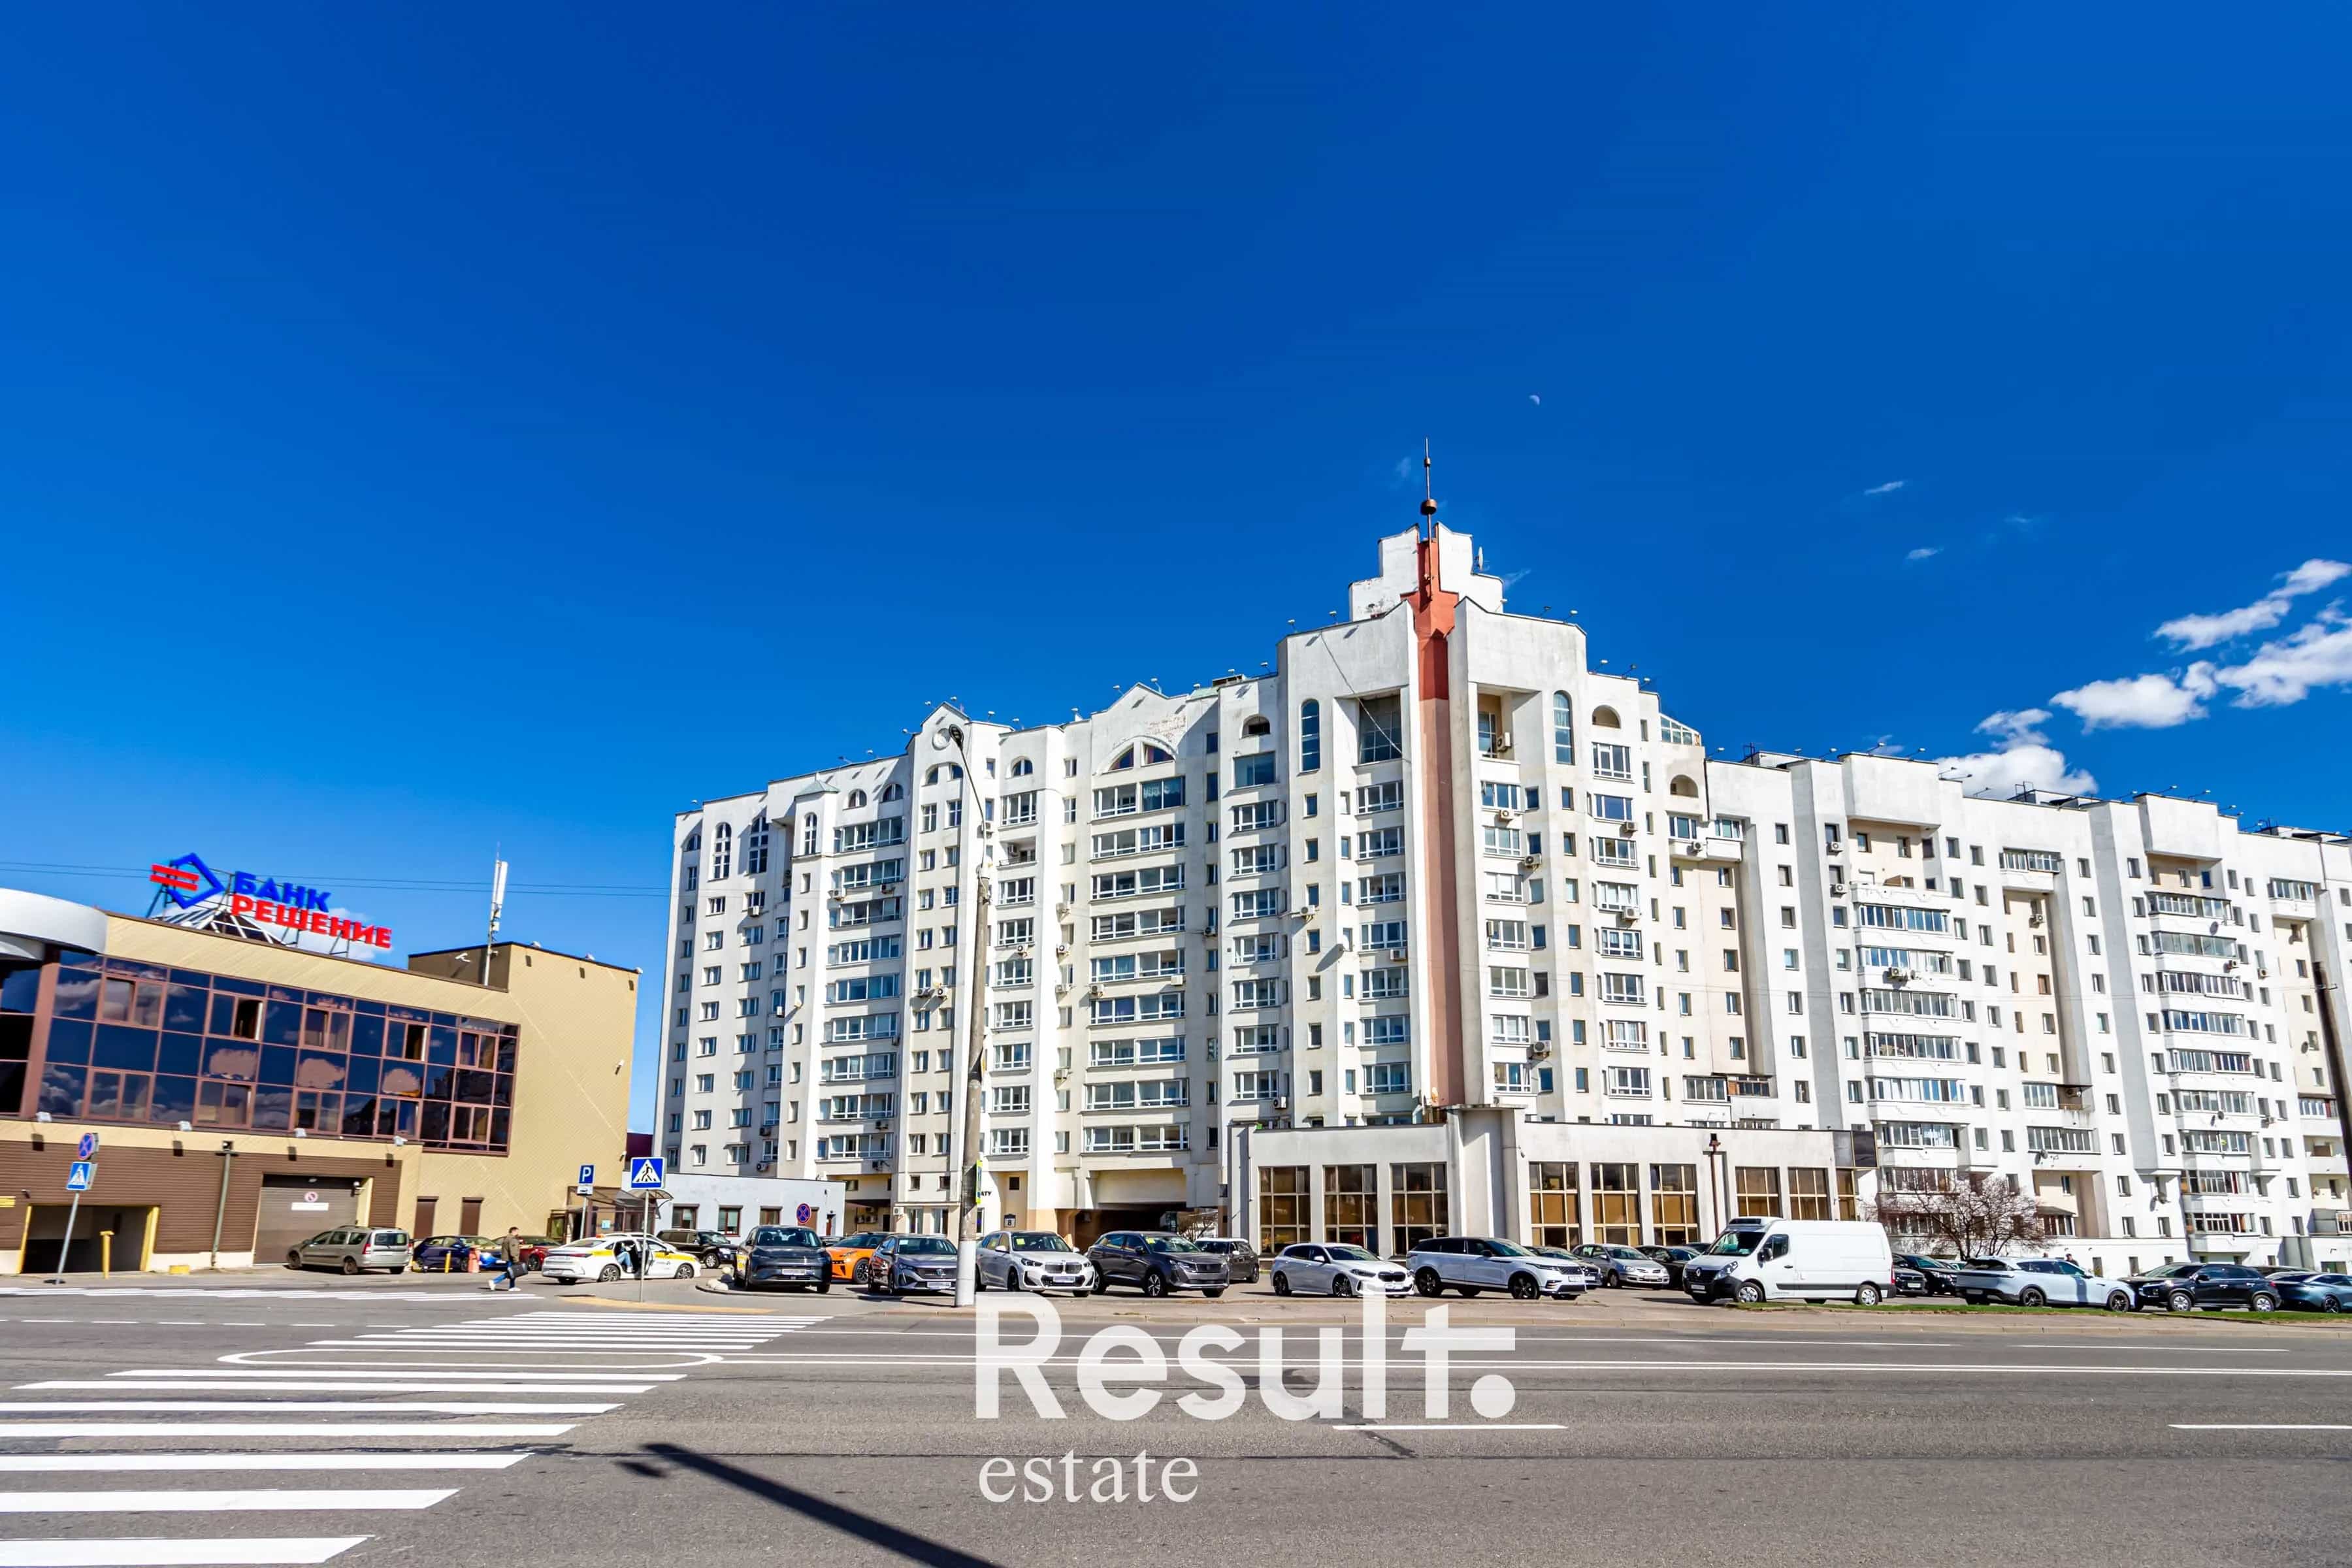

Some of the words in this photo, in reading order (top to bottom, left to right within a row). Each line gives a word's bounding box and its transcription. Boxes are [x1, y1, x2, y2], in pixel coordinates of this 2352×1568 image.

[235, 871, 331, 912] БАНК
[231, 893, 392, 949] РЕШЕНИЕ
[582, 1167, 591, 1182] P
